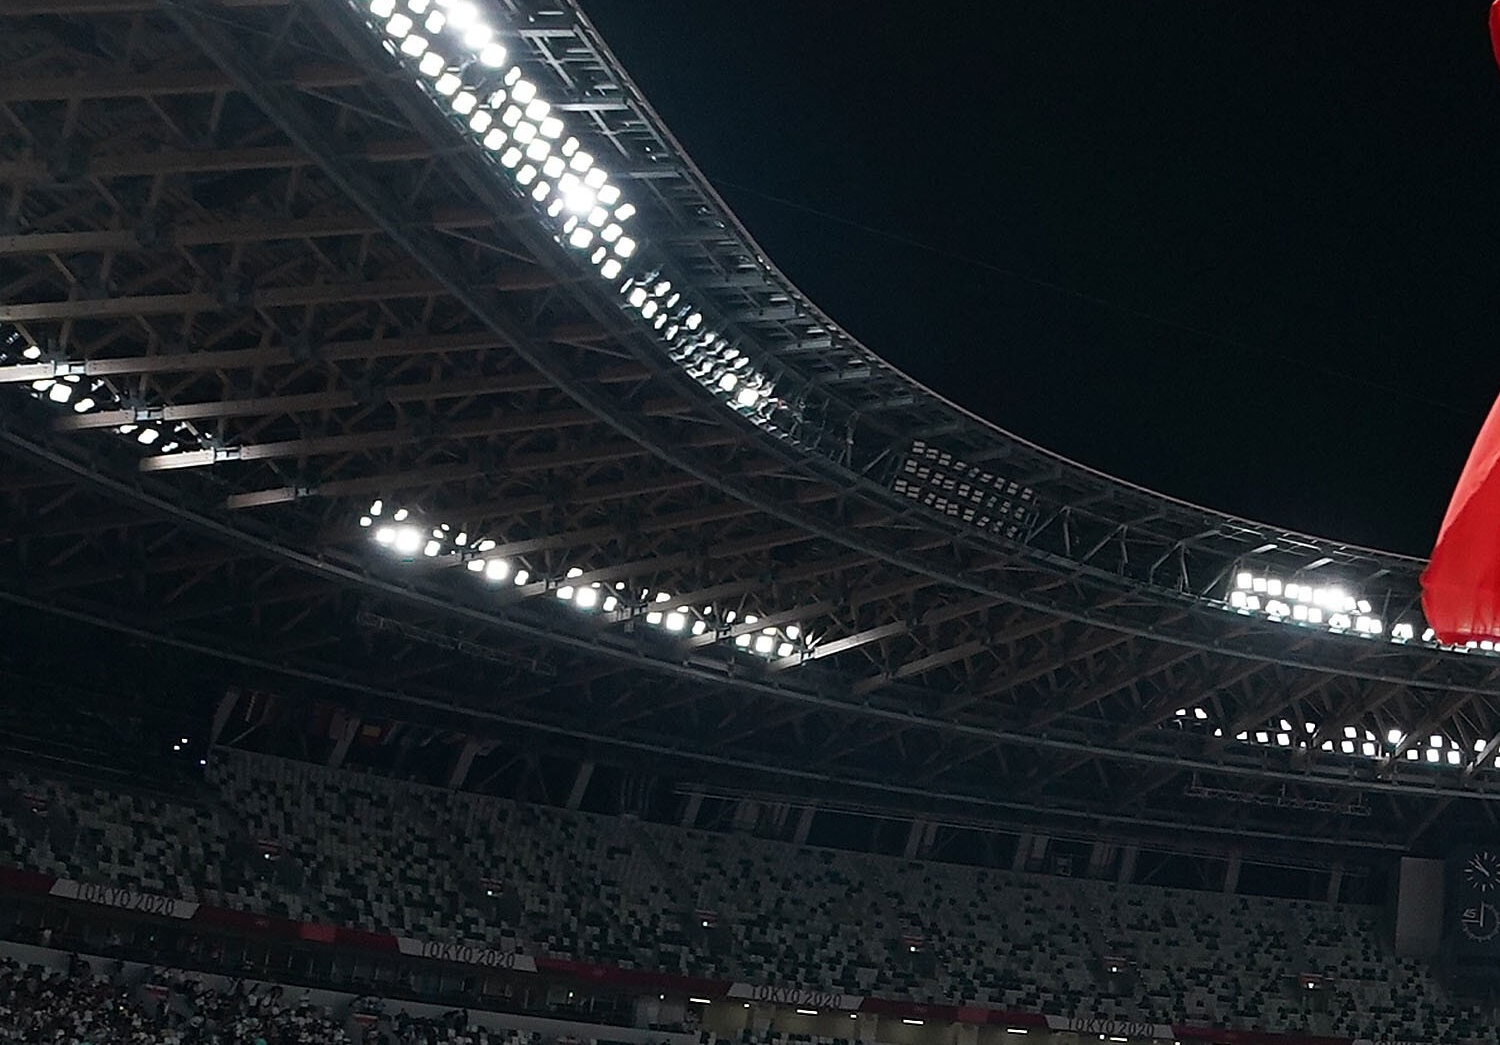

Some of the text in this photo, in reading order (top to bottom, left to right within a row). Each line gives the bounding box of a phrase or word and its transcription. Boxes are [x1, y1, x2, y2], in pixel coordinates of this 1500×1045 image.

[75, 881, 176, 916] TOKYO 2020
[423, 940, 515, 969] TOKYO 2020
[752, 984, 842, 1008] TOKYO 2020
[1068, 1017, 1154, 1038] TOKYO 2020
